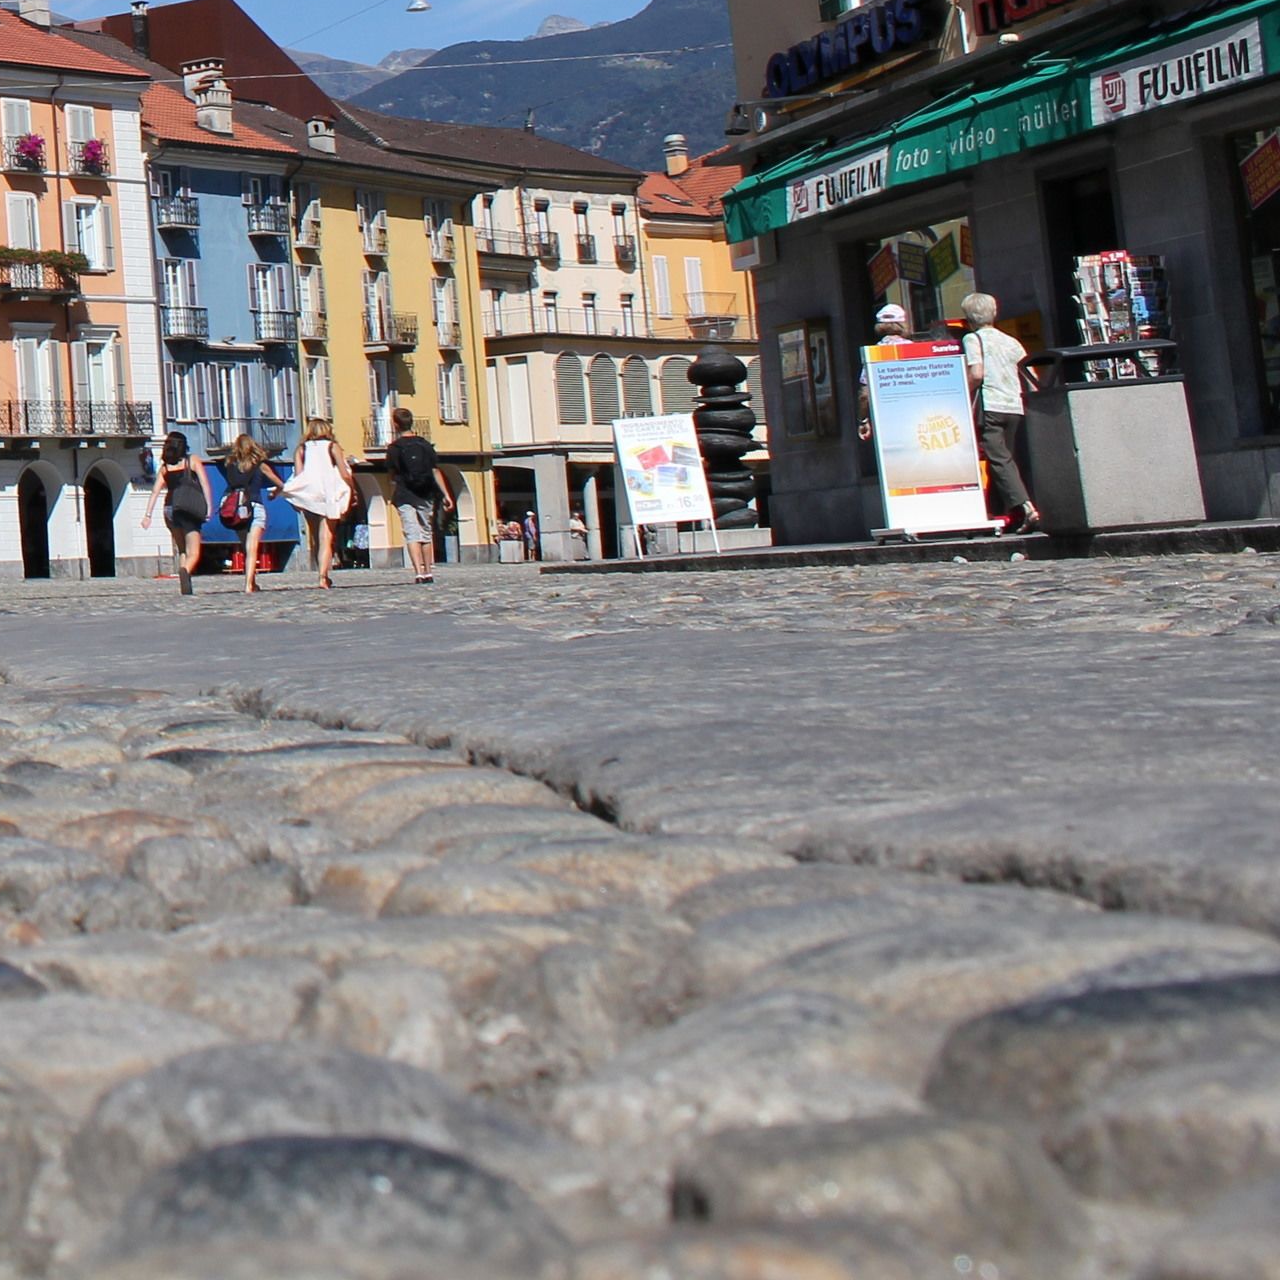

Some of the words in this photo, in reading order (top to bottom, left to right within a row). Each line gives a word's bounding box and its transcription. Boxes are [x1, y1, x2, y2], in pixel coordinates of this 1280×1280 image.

[1140, 38, 1250, 106] FUJIFILM
[896, 149, 930, 172] foto
[949, 127, 996, 156] video
[1018, 98, 1078, 132] müller
[816, 159, 881, 209] FUJIFILM
[931, 344, 960, 353] Sunrise
[918, 426, 961, 451] SALE
